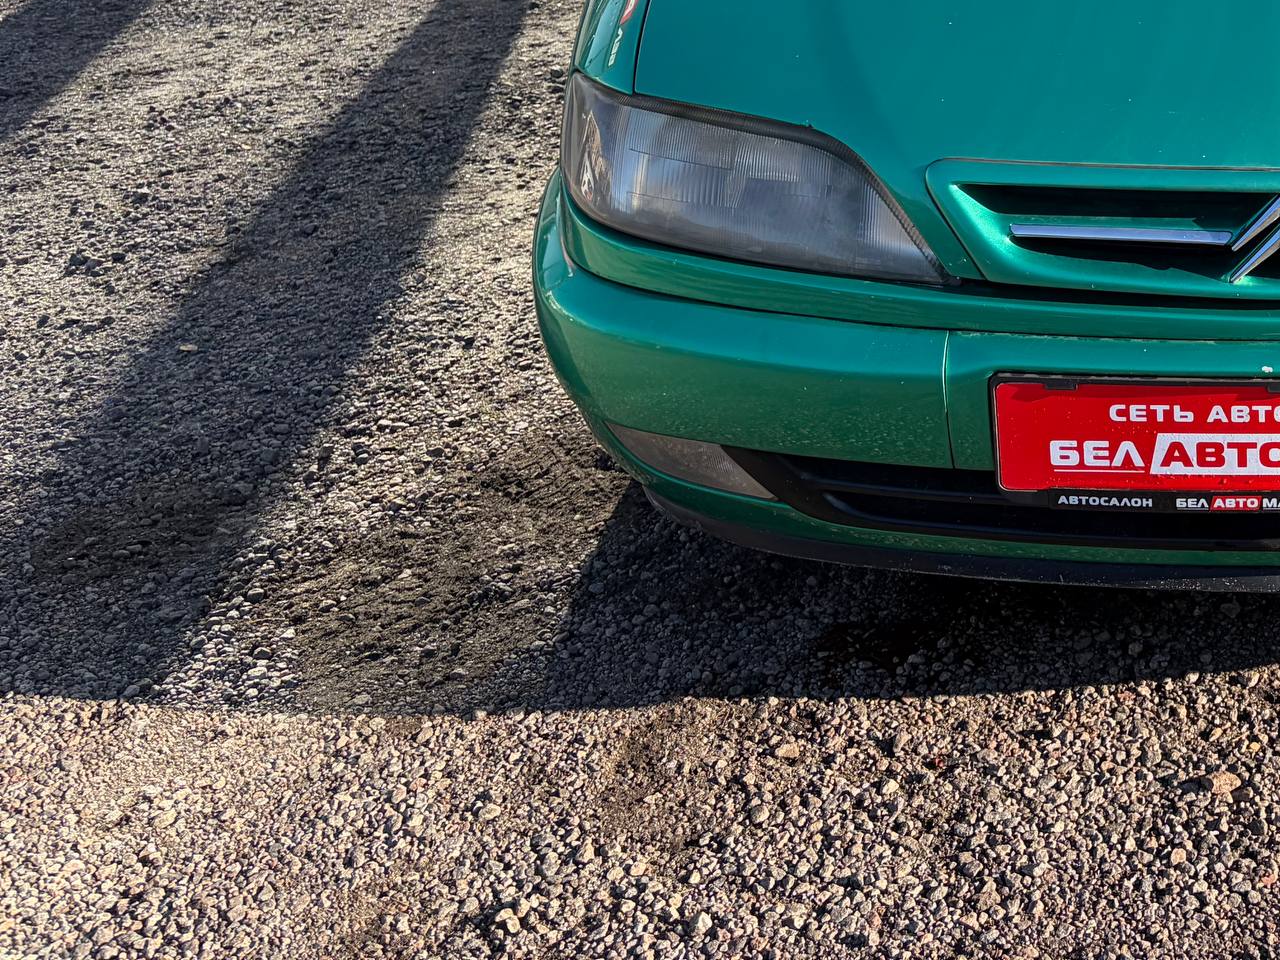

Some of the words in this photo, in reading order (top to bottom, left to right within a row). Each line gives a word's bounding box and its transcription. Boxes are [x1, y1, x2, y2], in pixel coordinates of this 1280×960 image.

[1109, 404, 1195, 422] СЕТЬ
[1049, 439, 1145, 468] БЕЛ
[1057, 495, 1153, 508] АВТОСАЛОН
[1175, 498, 1209, 509] БЕЛ
[1212, 498, 1260, 508] АВТО
